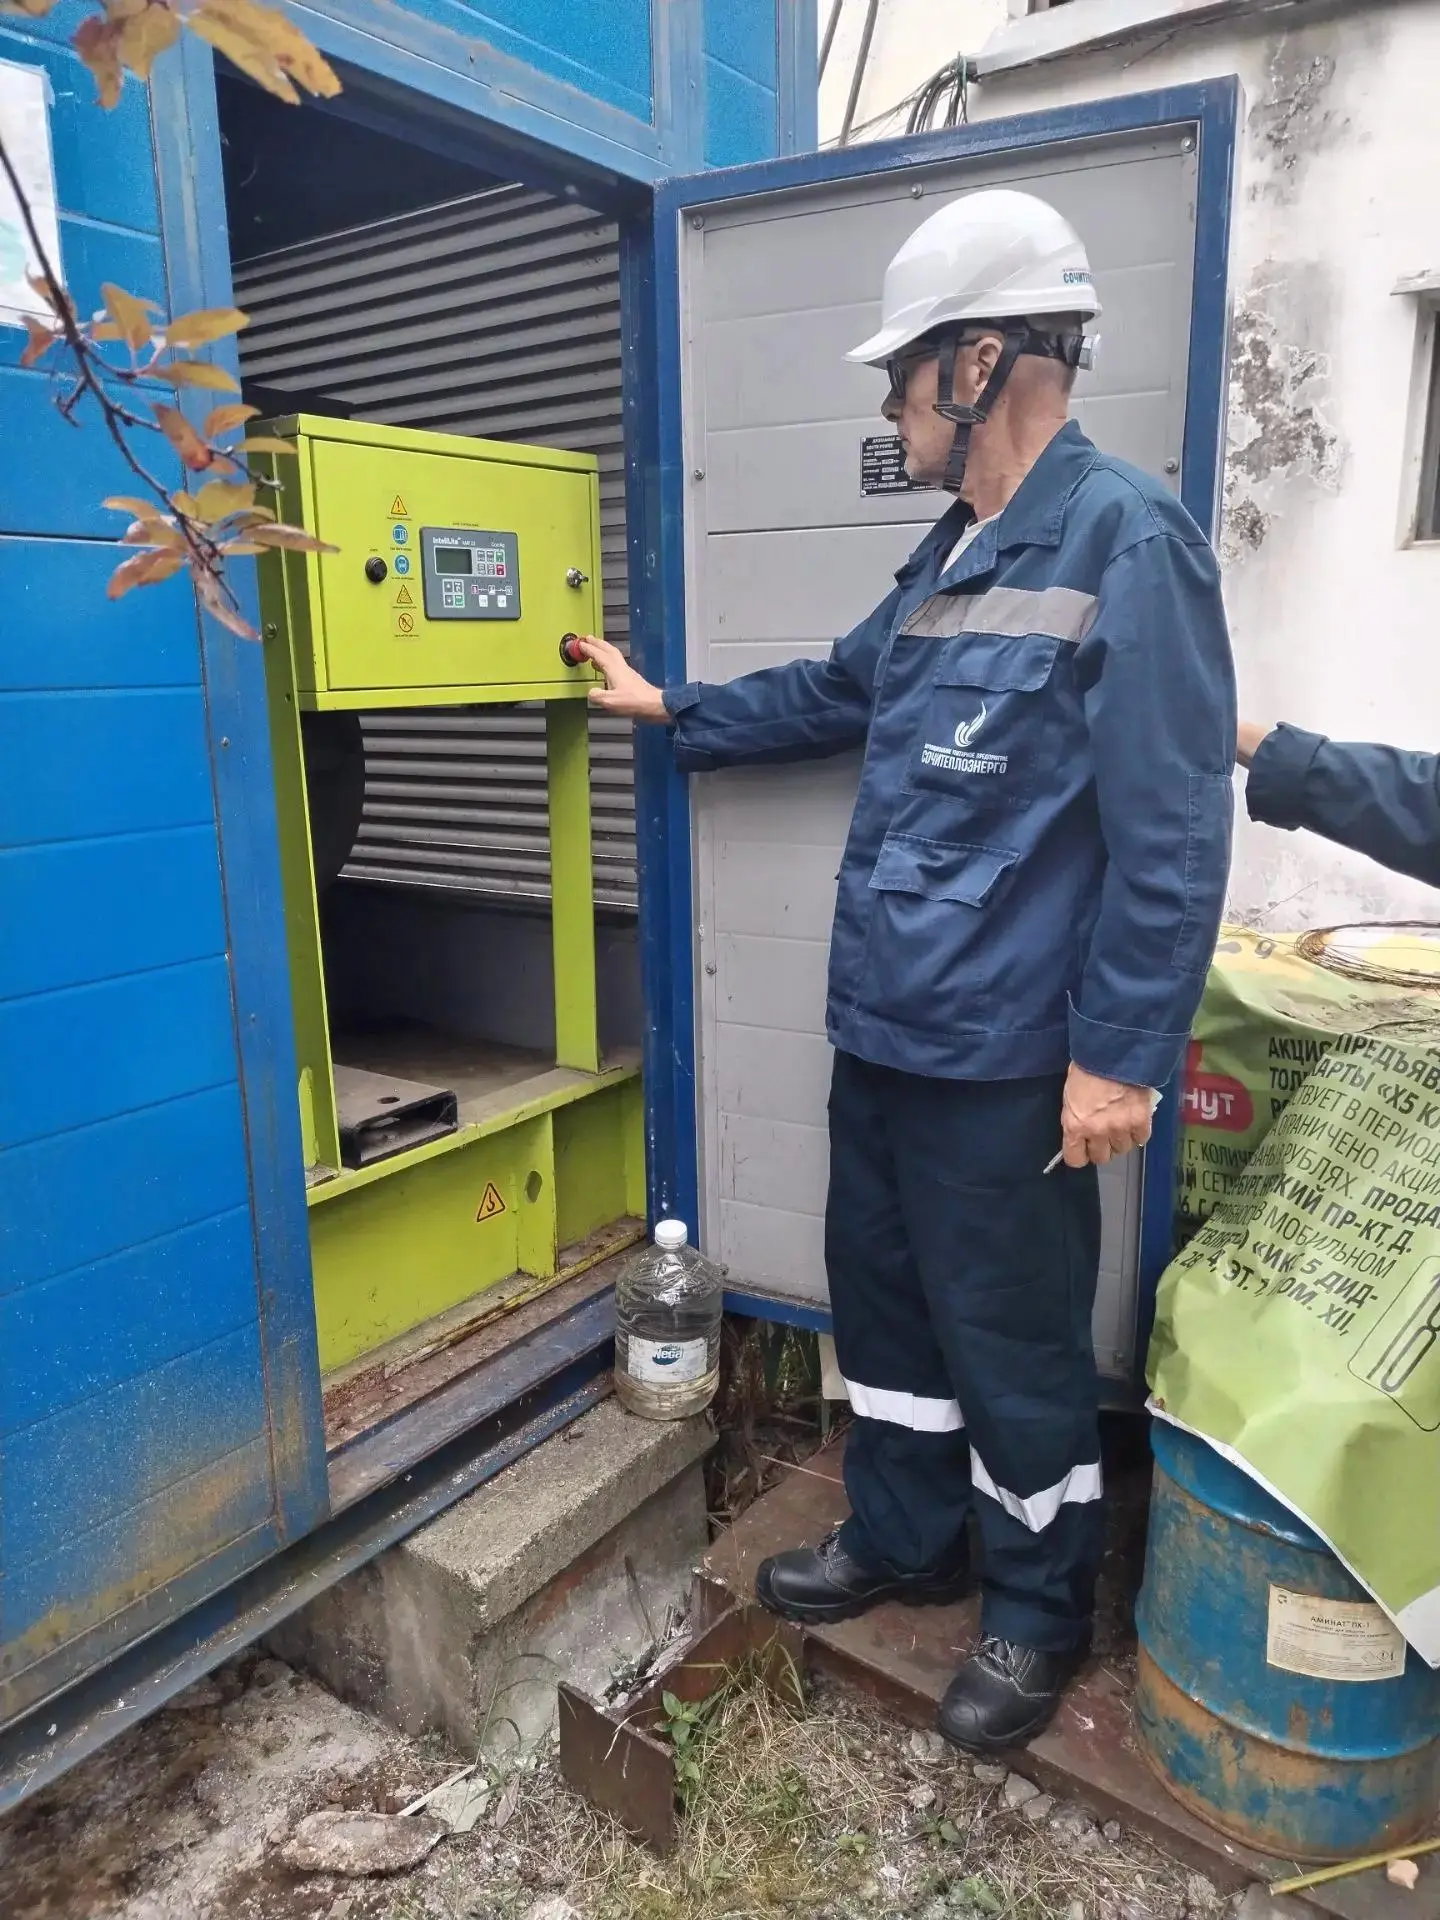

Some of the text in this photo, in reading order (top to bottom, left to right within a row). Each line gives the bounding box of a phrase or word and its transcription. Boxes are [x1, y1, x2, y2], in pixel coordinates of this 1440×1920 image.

[921, 749, 1007, 774] СОЧИТЕПЛОЭНЕРГО
[1335, 1032, 1440, 1095] ПРЕДЪЯВ
[1342, 1098, 1362, 1121] В
[1380, 1159, 1440, 1196] АКЦИ
[1361, 1185, 1440, 1230] ПРОДА
[1263, 1205, 1397, 1279] МОБИЛЬНОМ
[1387, 1229, 1415, 1256] Д.
